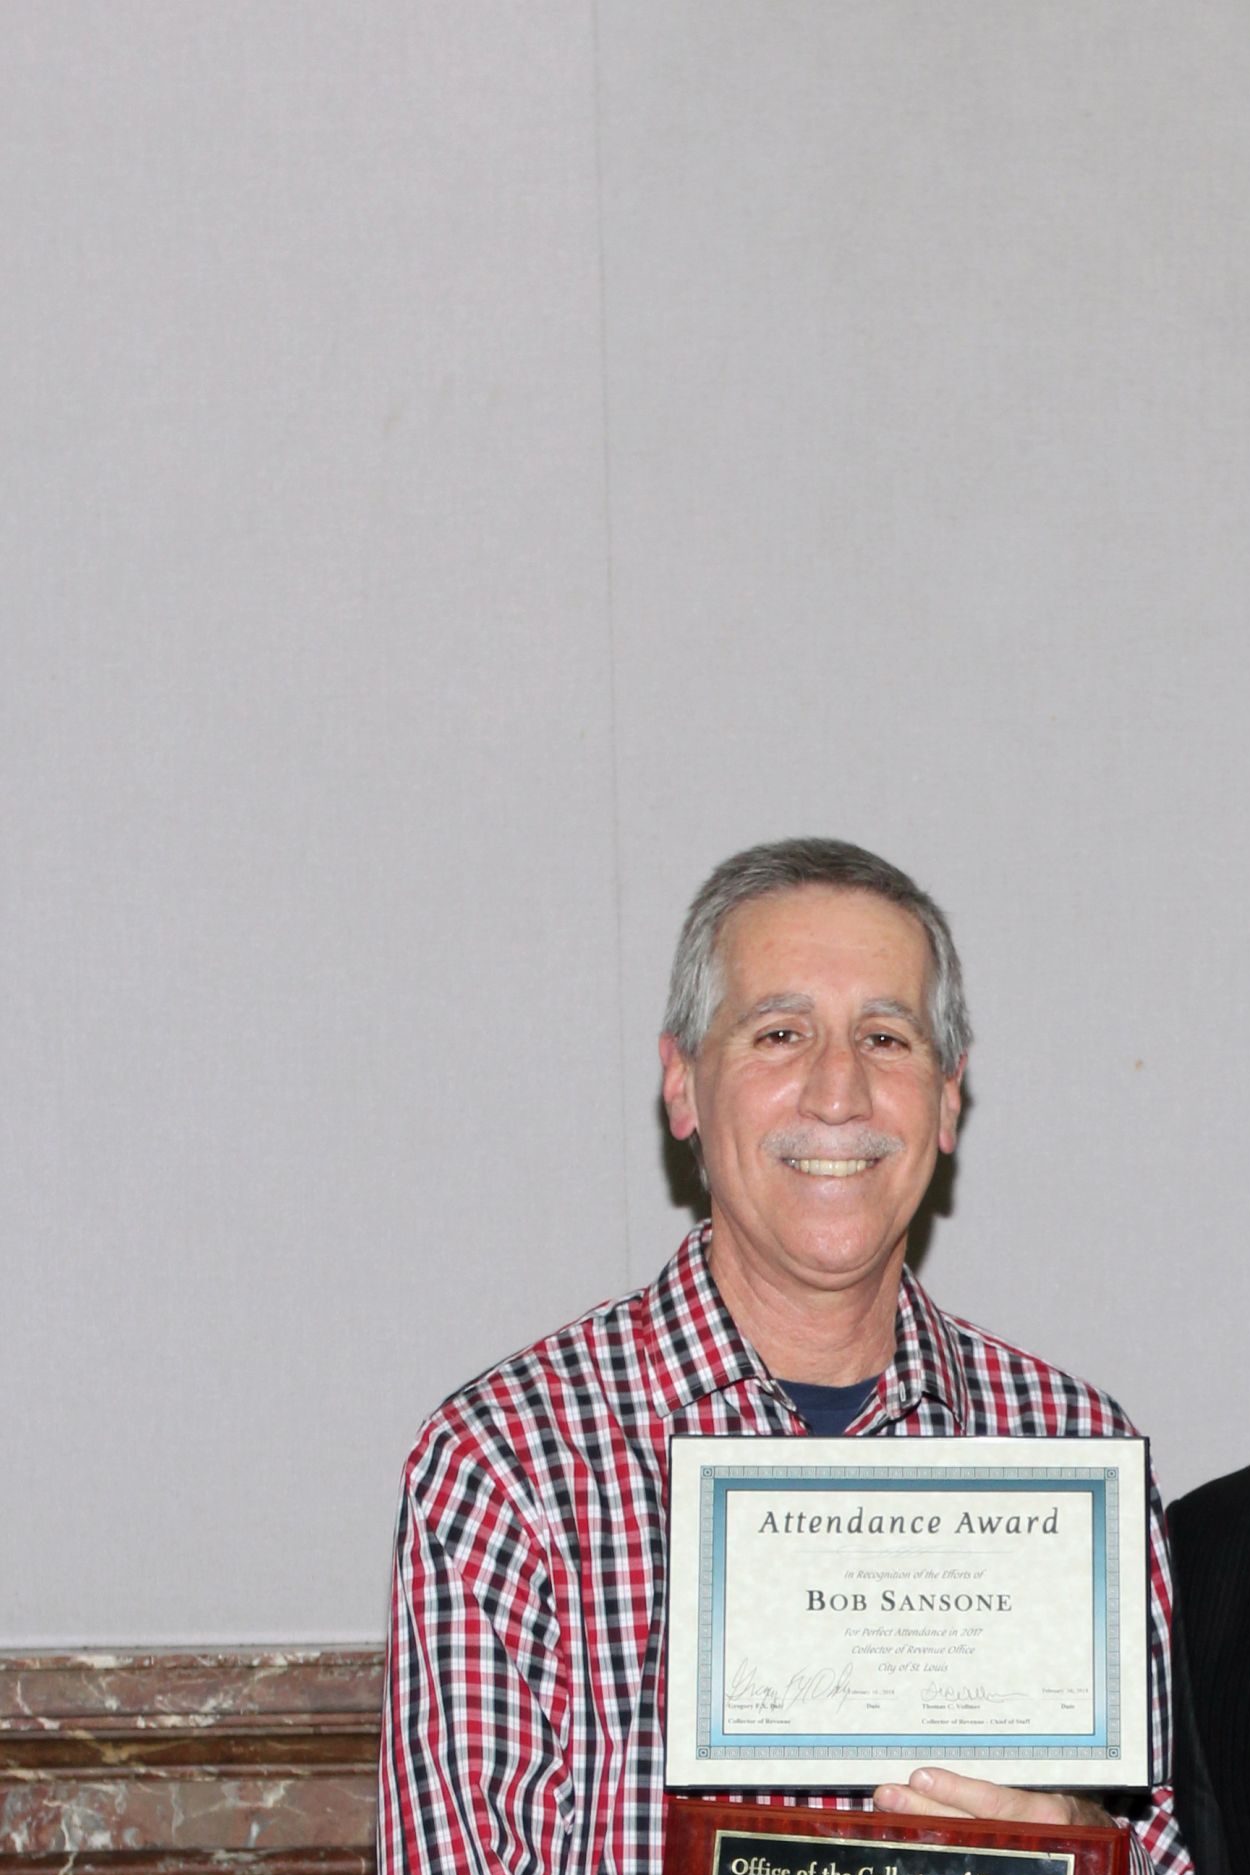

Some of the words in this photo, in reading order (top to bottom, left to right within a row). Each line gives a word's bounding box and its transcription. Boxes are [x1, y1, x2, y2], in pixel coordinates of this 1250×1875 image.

[757, 1506, 942, 1535] Attendance
[953, 1507, 1060, 1535] Award
[843, 1570, 854, 1579] In
[857, 1570, 911, 1582] Recognition
[913, 1570, 925, 1579] of
[925, 1570, 940, 1579] the
[942, 1569, 971, 1579] Efforts
[973, 1569, 985, 1579] of
[844, 1628, 860, 1637] For
[862, 1628, 893, 1637] Perfect
[895, 1628, 947, 1637] Attendance
[949, 1628, 958, 1637] in
[960, 1628, 983, 1637] 2017
[851, 1646, 893, 1655] Collector
[894, 1645, 906, 1655] of
[907, 1646, 945, 1655] Revenue
[948, 1645, 976, 1655] Office
[878, 1663, 896, 1674] City
[898, 1662, 909, 1672] of
[923, 1663, 948, 1673] Louis
